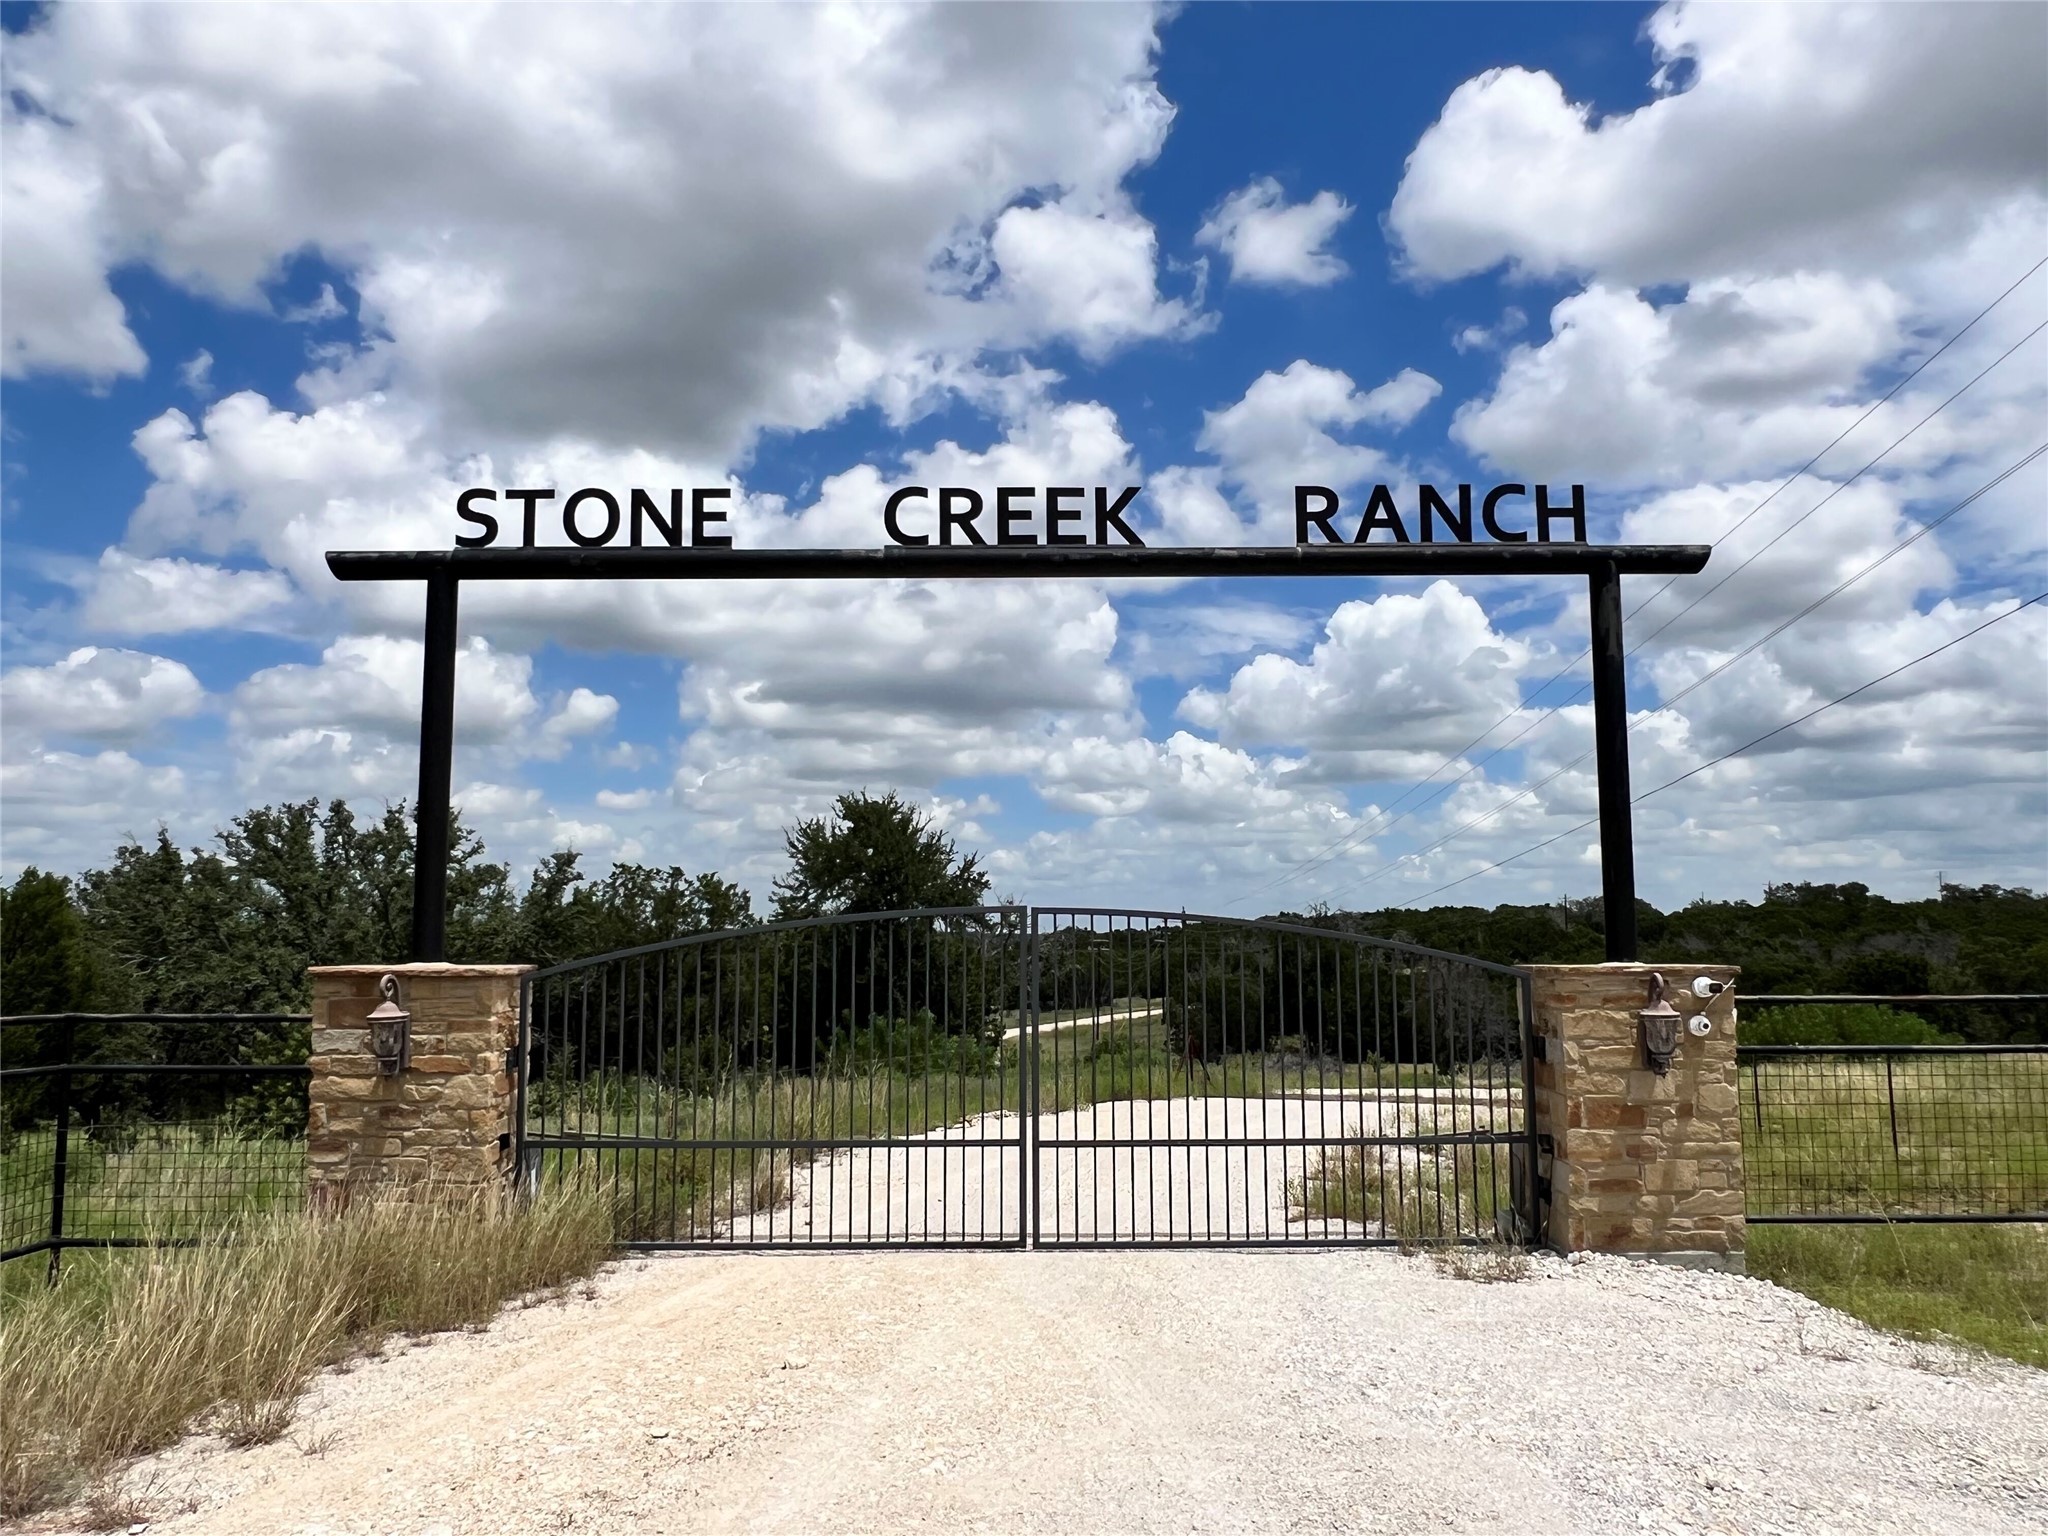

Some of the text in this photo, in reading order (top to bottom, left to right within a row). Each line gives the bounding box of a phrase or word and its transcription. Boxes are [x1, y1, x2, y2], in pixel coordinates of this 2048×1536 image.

[455, 484, 1586, 548] STONE CREEK RANCH
